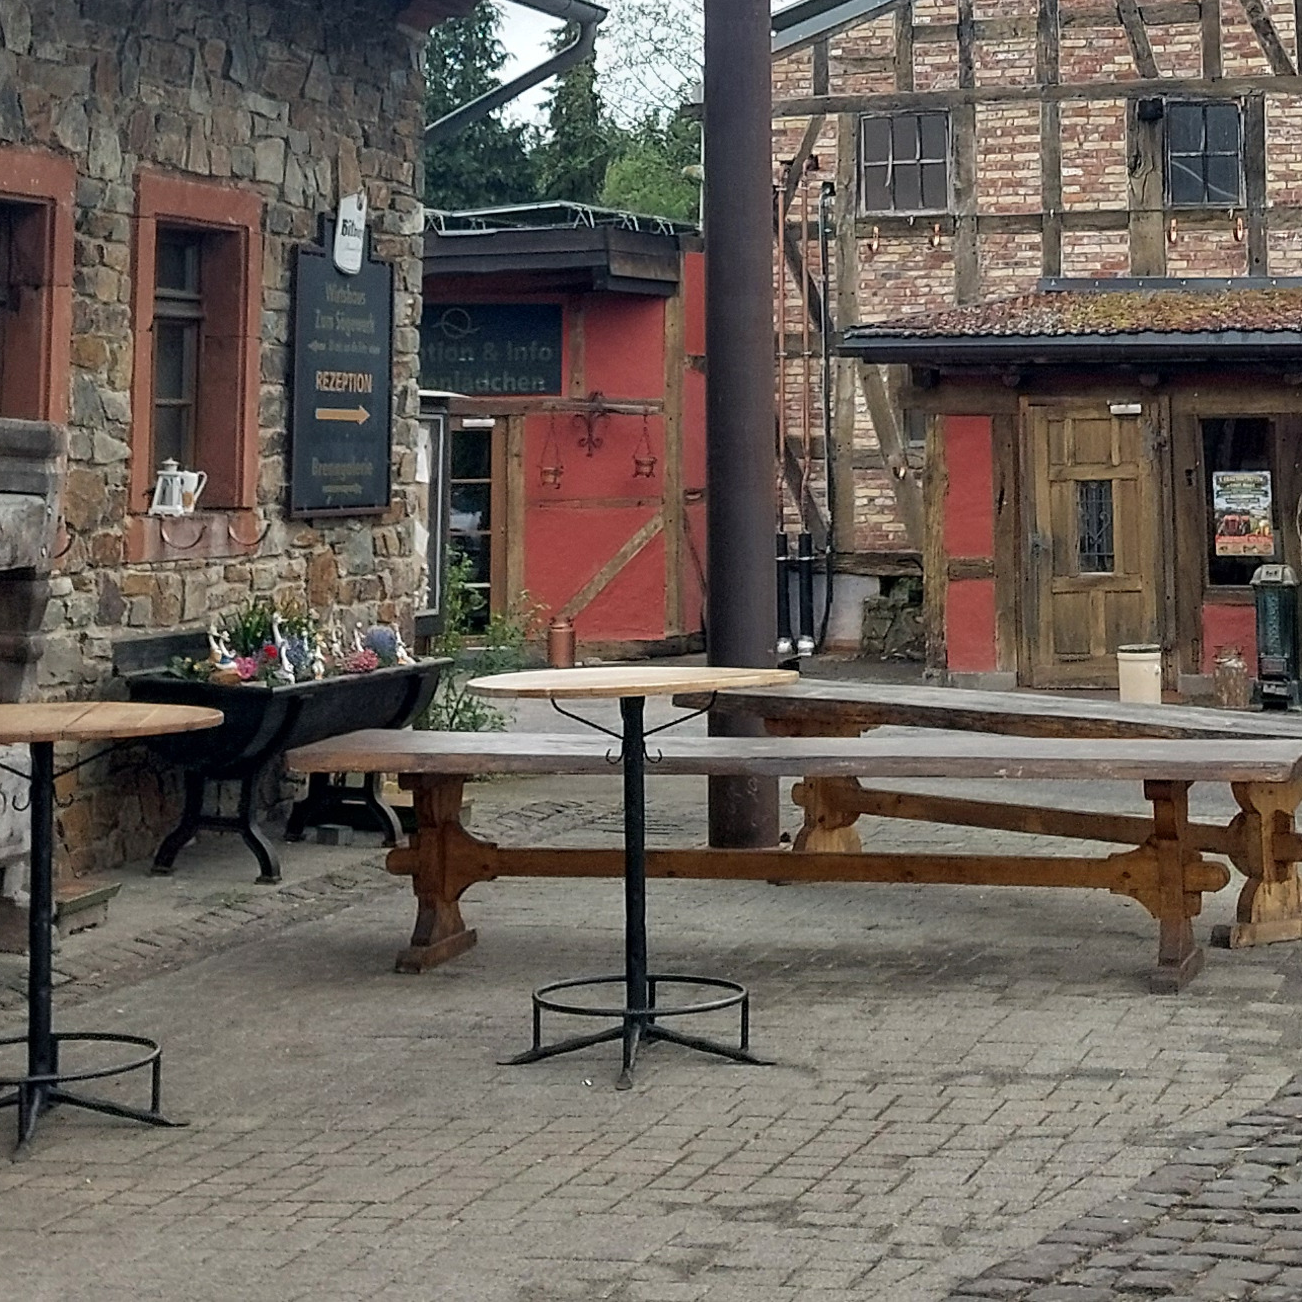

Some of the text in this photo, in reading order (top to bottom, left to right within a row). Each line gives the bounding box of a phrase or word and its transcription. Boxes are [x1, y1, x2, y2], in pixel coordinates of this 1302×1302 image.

[482, 341, 499, 362] &
[506, 339, 554, 363] Info
[315, 370, 373, 394] REZEPTION
